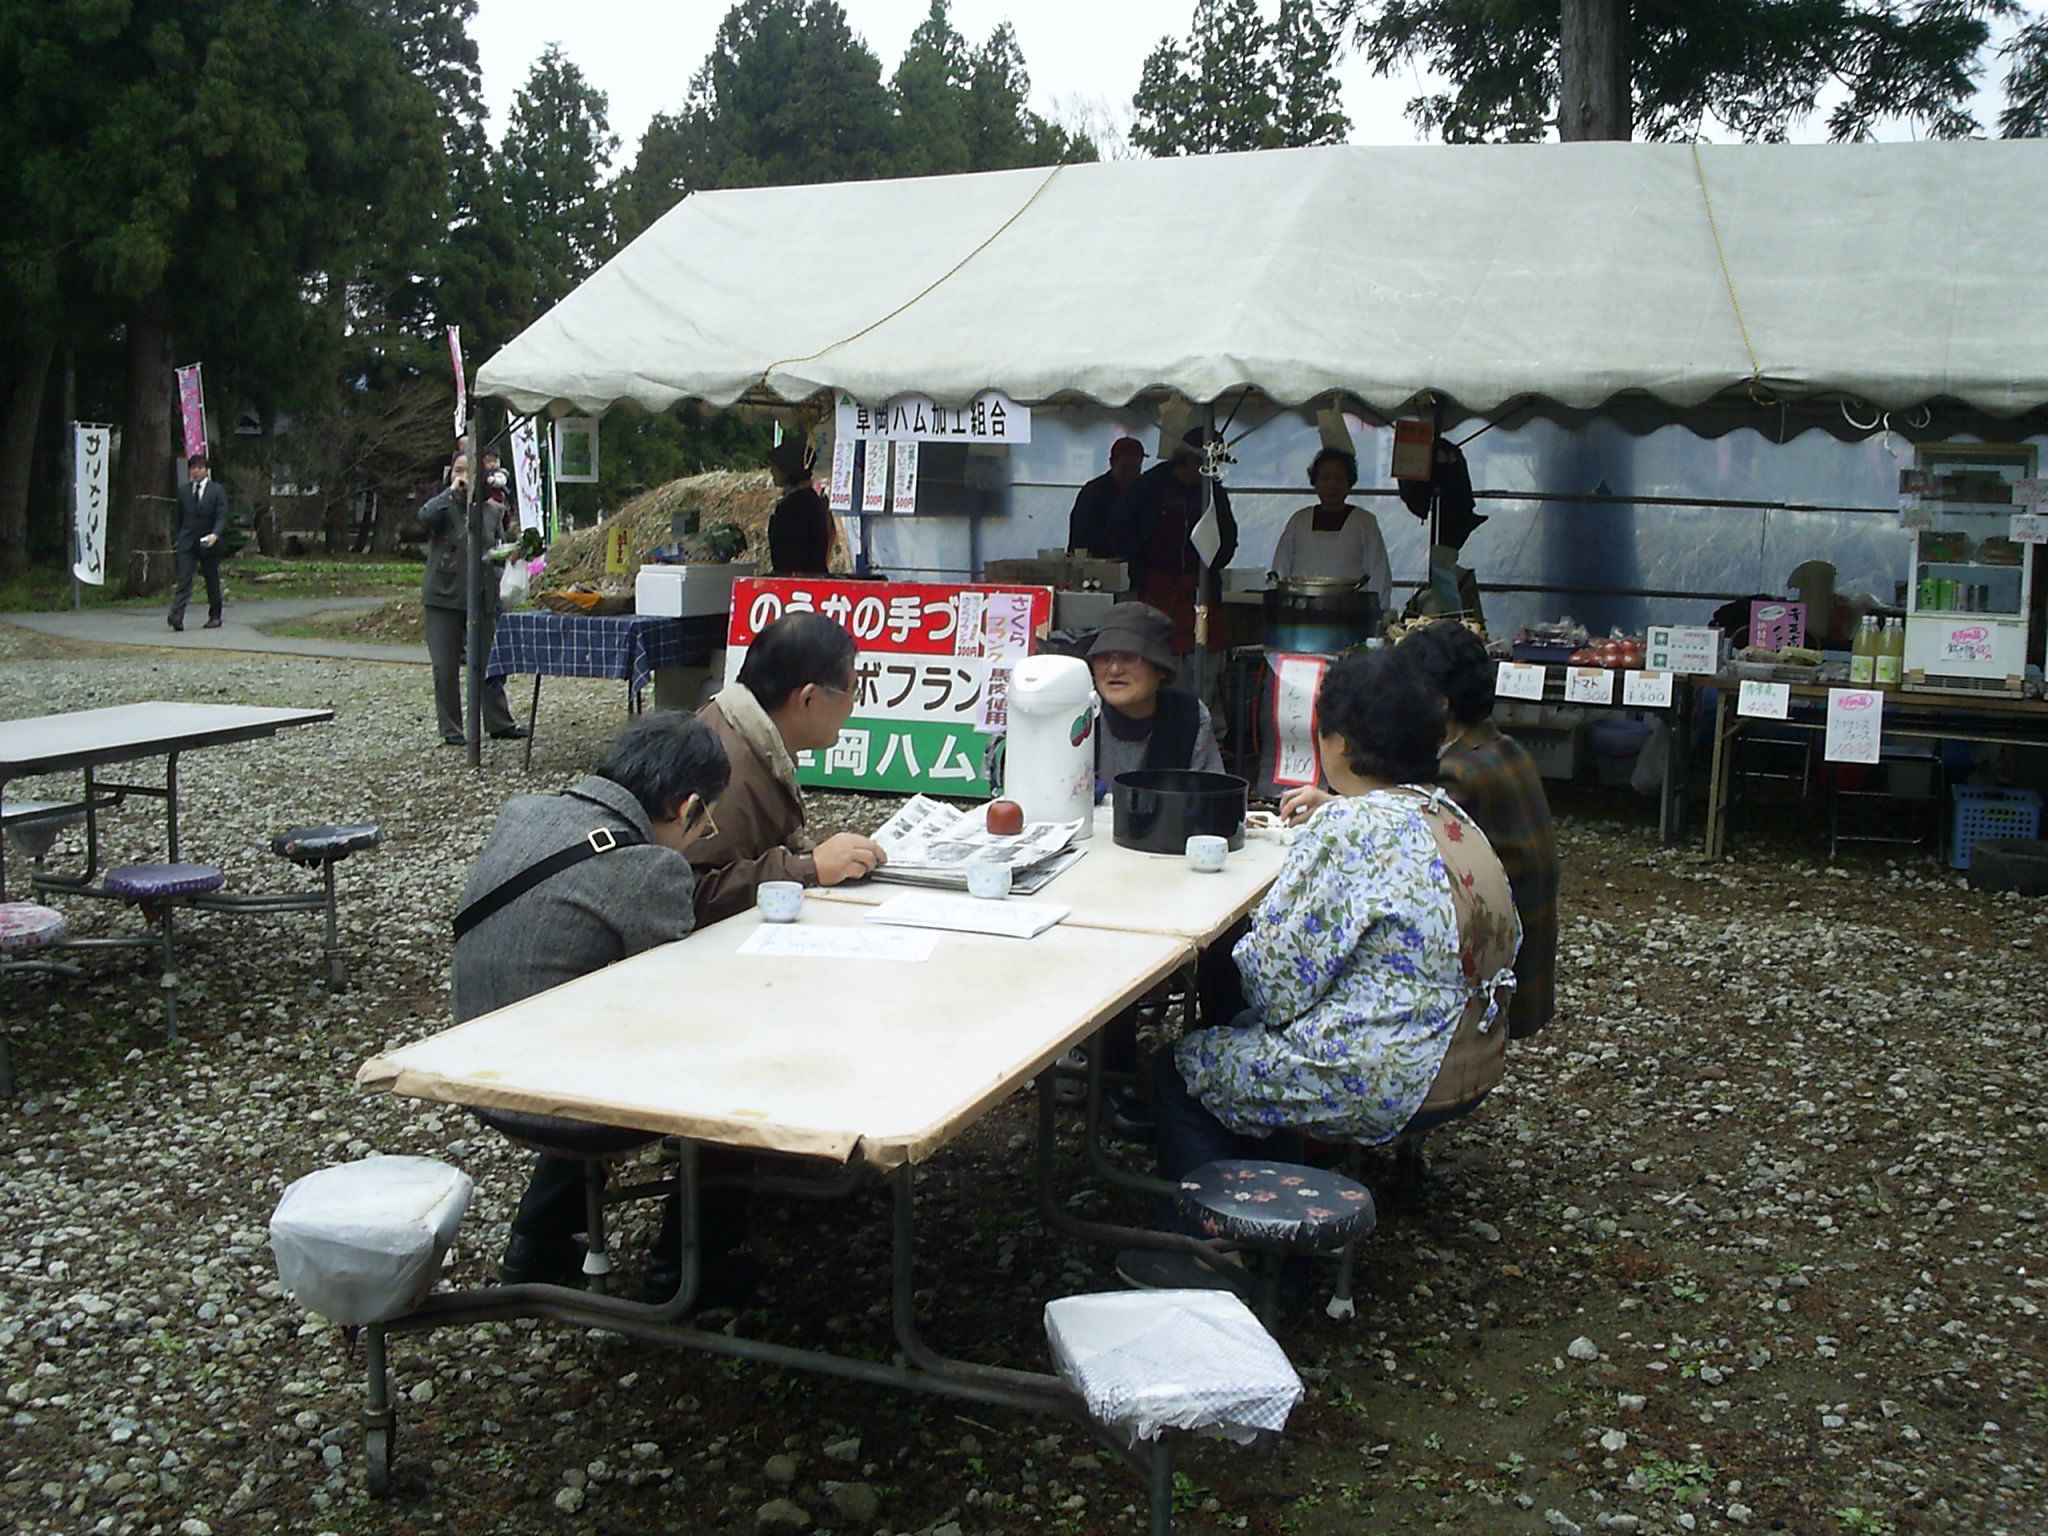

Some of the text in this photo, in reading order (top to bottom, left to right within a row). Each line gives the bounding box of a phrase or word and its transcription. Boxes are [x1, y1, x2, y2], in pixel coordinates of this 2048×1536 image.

[856, 400, 1006, 436] 草岡ハム加工組合
[1009, 596, 1029, 648] さくら
[1573, 675, 1599, 689] トマト
